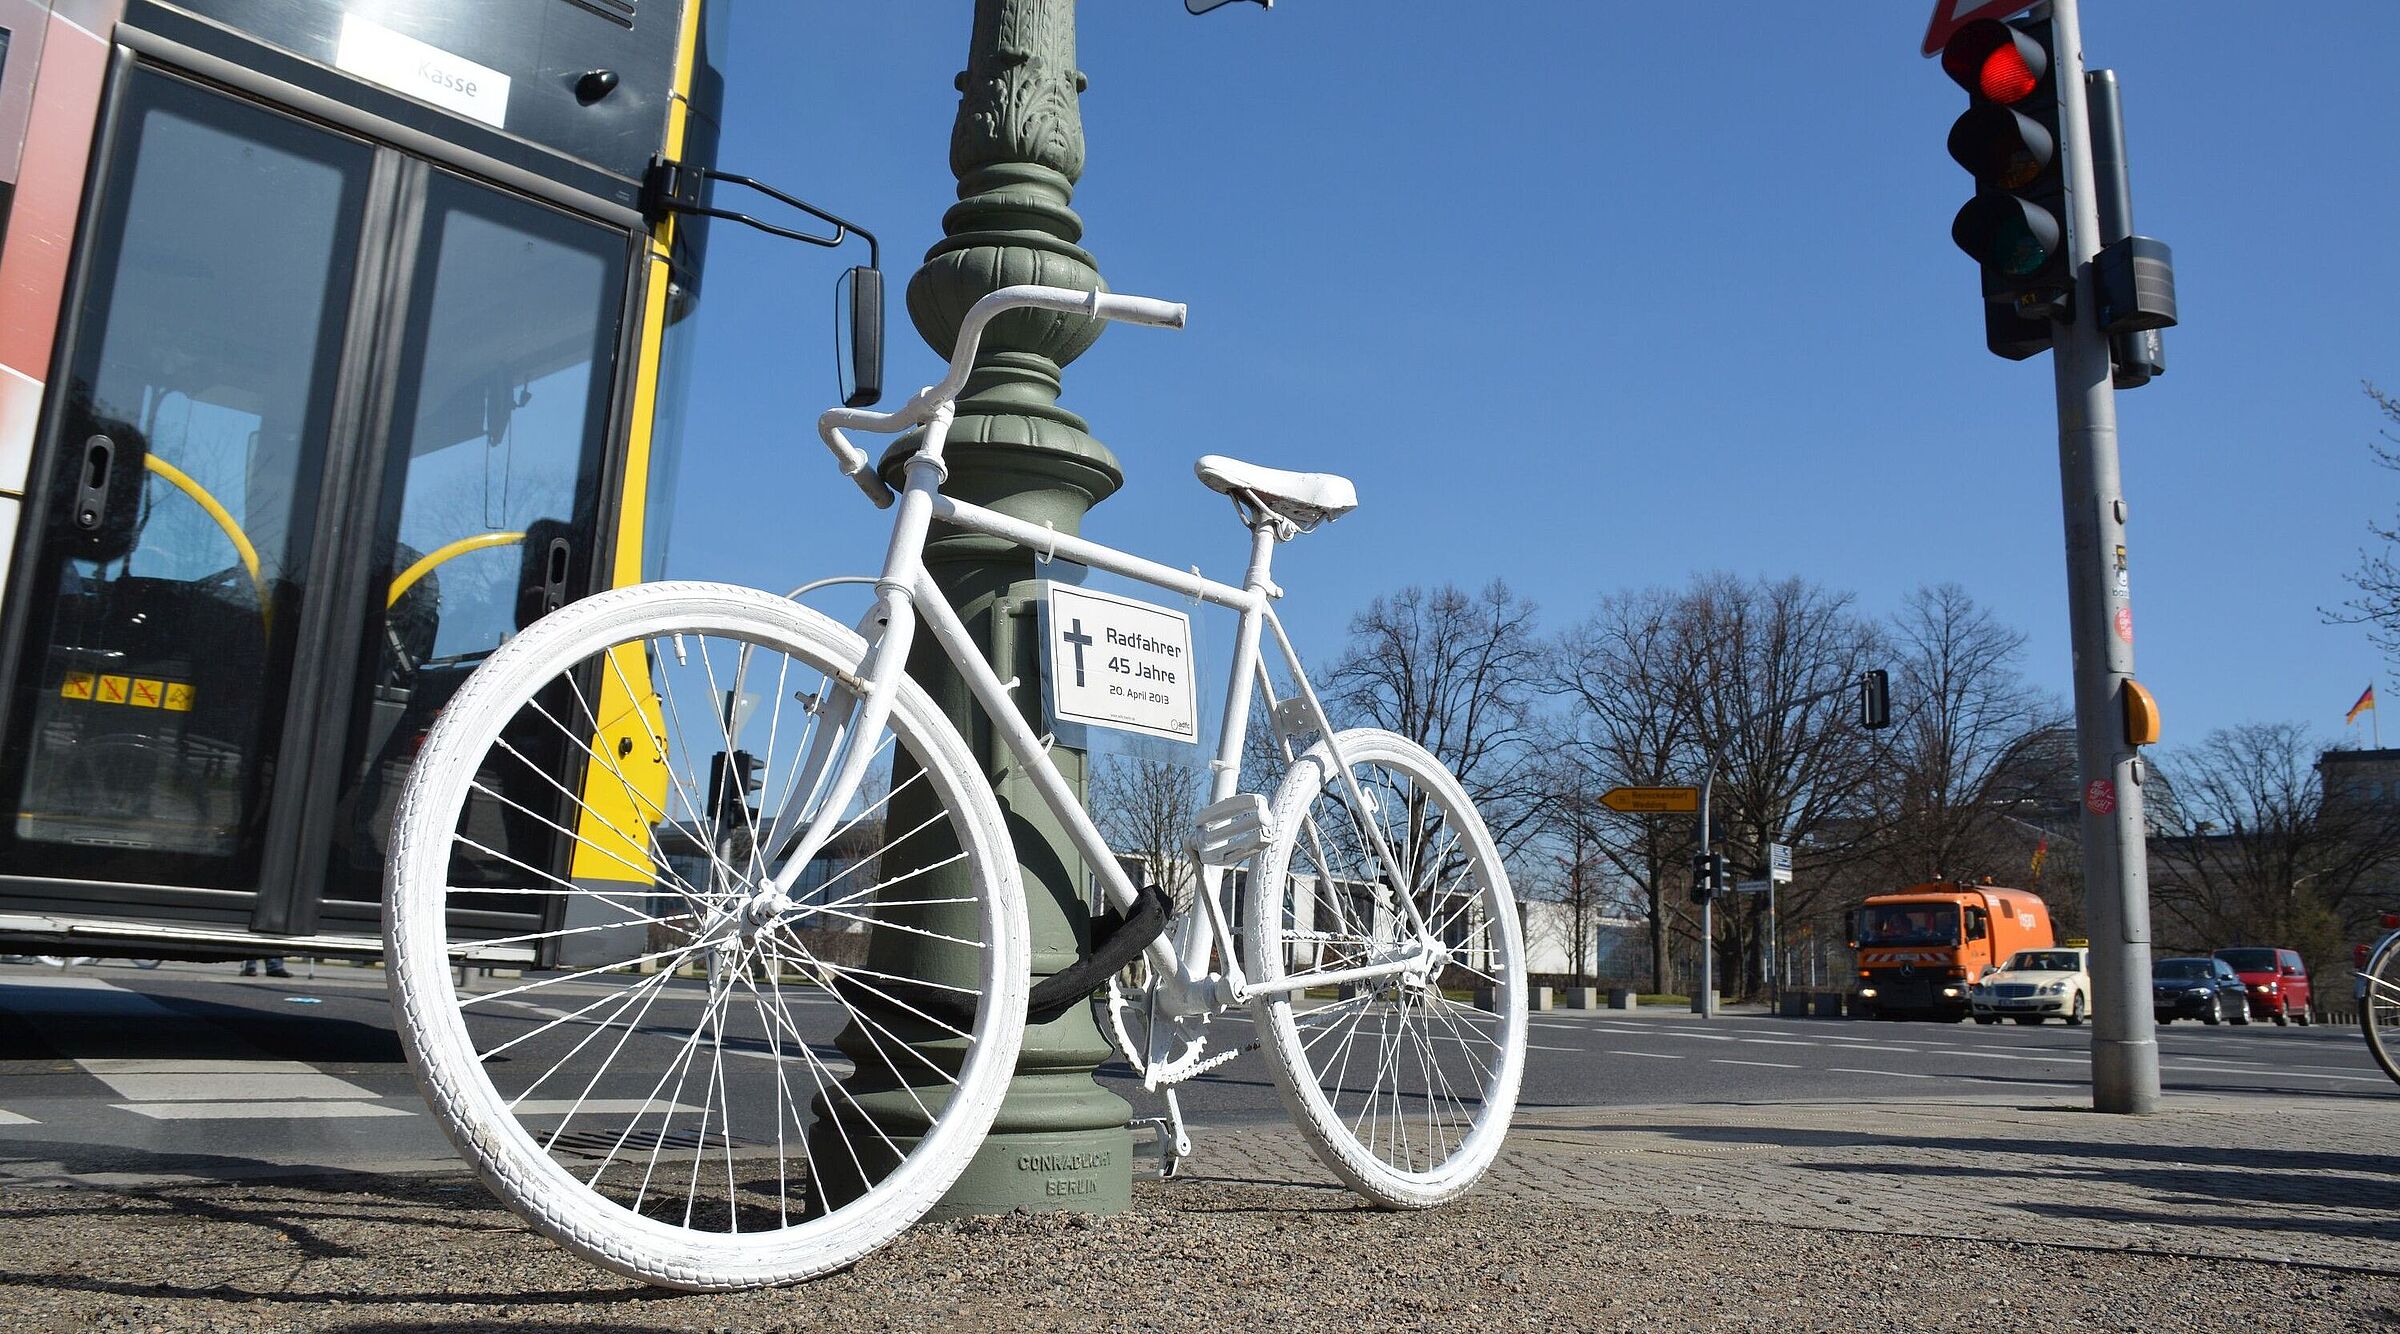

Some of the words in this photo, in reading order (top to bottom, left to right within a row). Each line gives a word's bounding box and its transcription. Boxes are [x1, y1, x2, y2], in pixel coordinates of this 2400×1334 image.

[1106, 627, 1182, 658] Radfahrer
[1108, 656, 1131, 675] 45
[1135, 661, 1176, 684] Jahre
[1109, 684, 1125, 697] 20.
[1127, 688, 1147, 701] April
[1149, 692, 1170, 705] 2013
[1046, 1179, 1097, 1196] BERLIN
